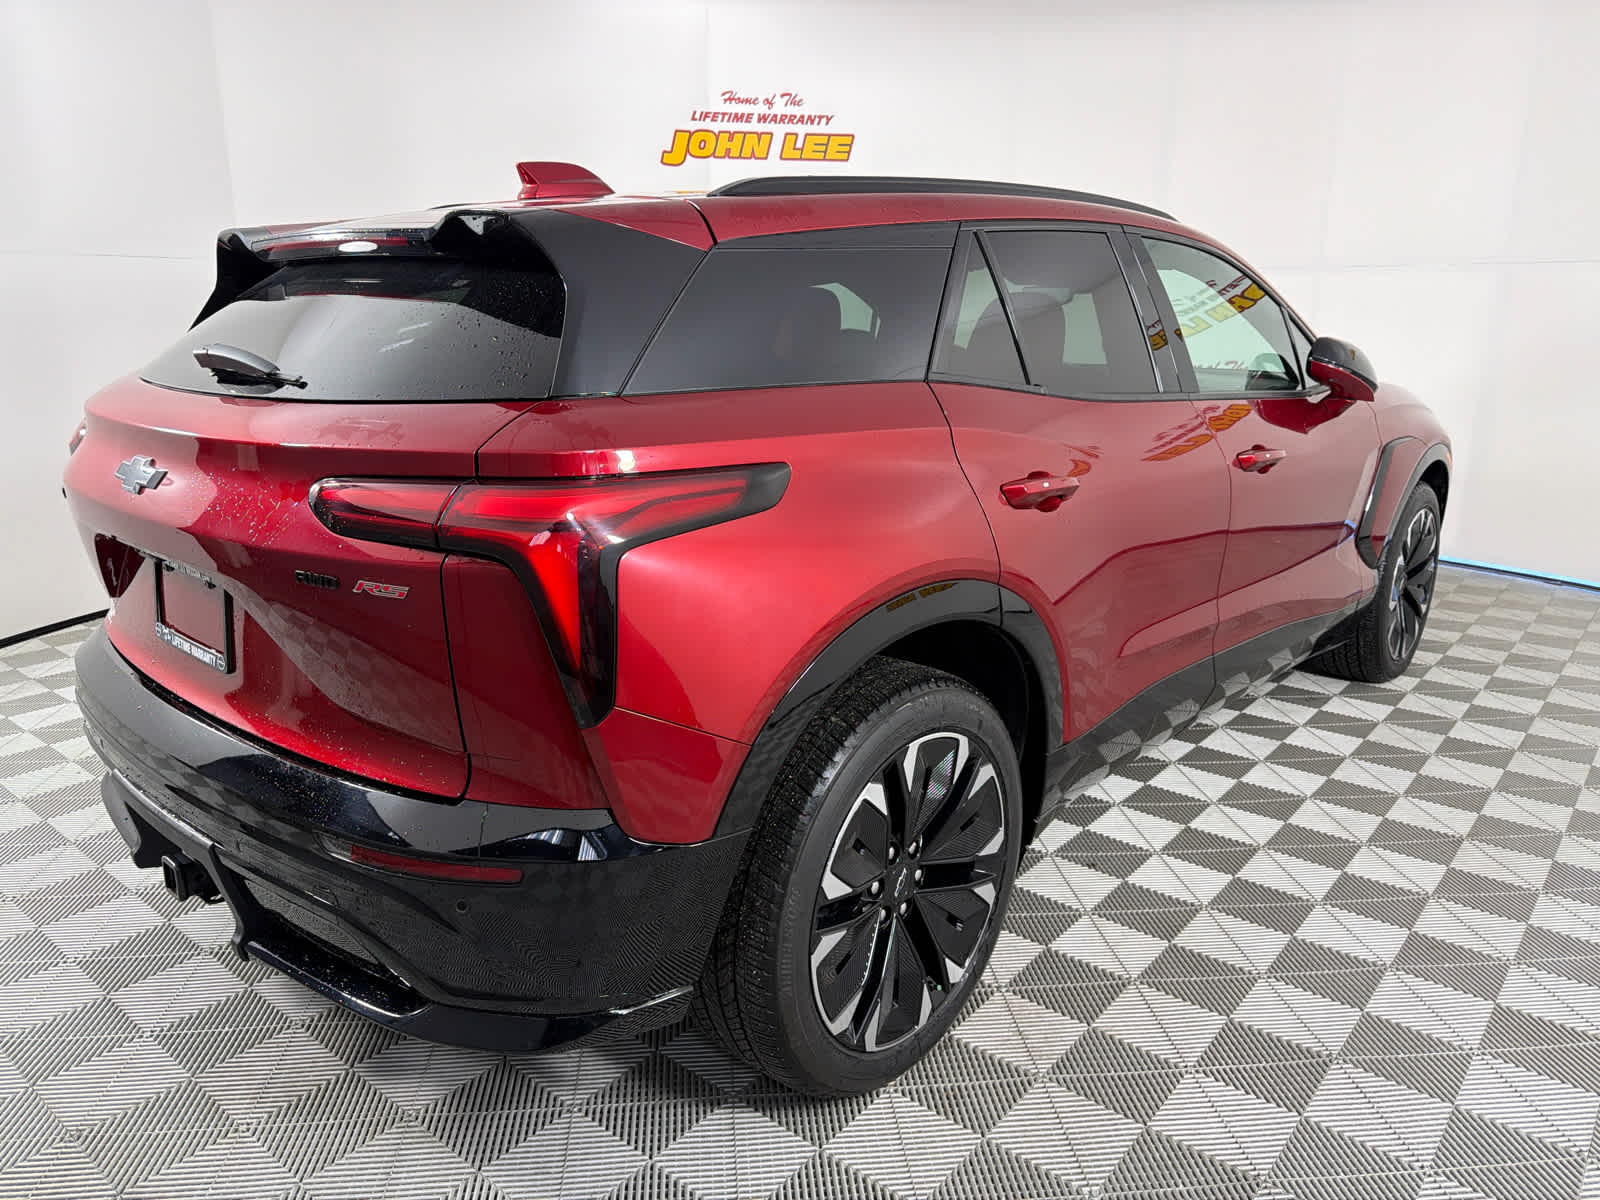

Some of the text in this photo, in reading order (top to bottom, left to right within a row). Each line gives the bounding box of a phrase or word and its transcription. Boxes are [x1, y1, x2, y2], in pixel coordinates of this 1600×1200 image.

[720, 90, 805, 110] Home of The
[690, 110, 834, 126] LIFETIME WARRANTY
[660, 129, 855, 167] JOHN LEE
[352, 579, 411, 600] RS
[171, 635, 192, 655] LIFETIME
[191, 644, 217, 667] WARRANTY
